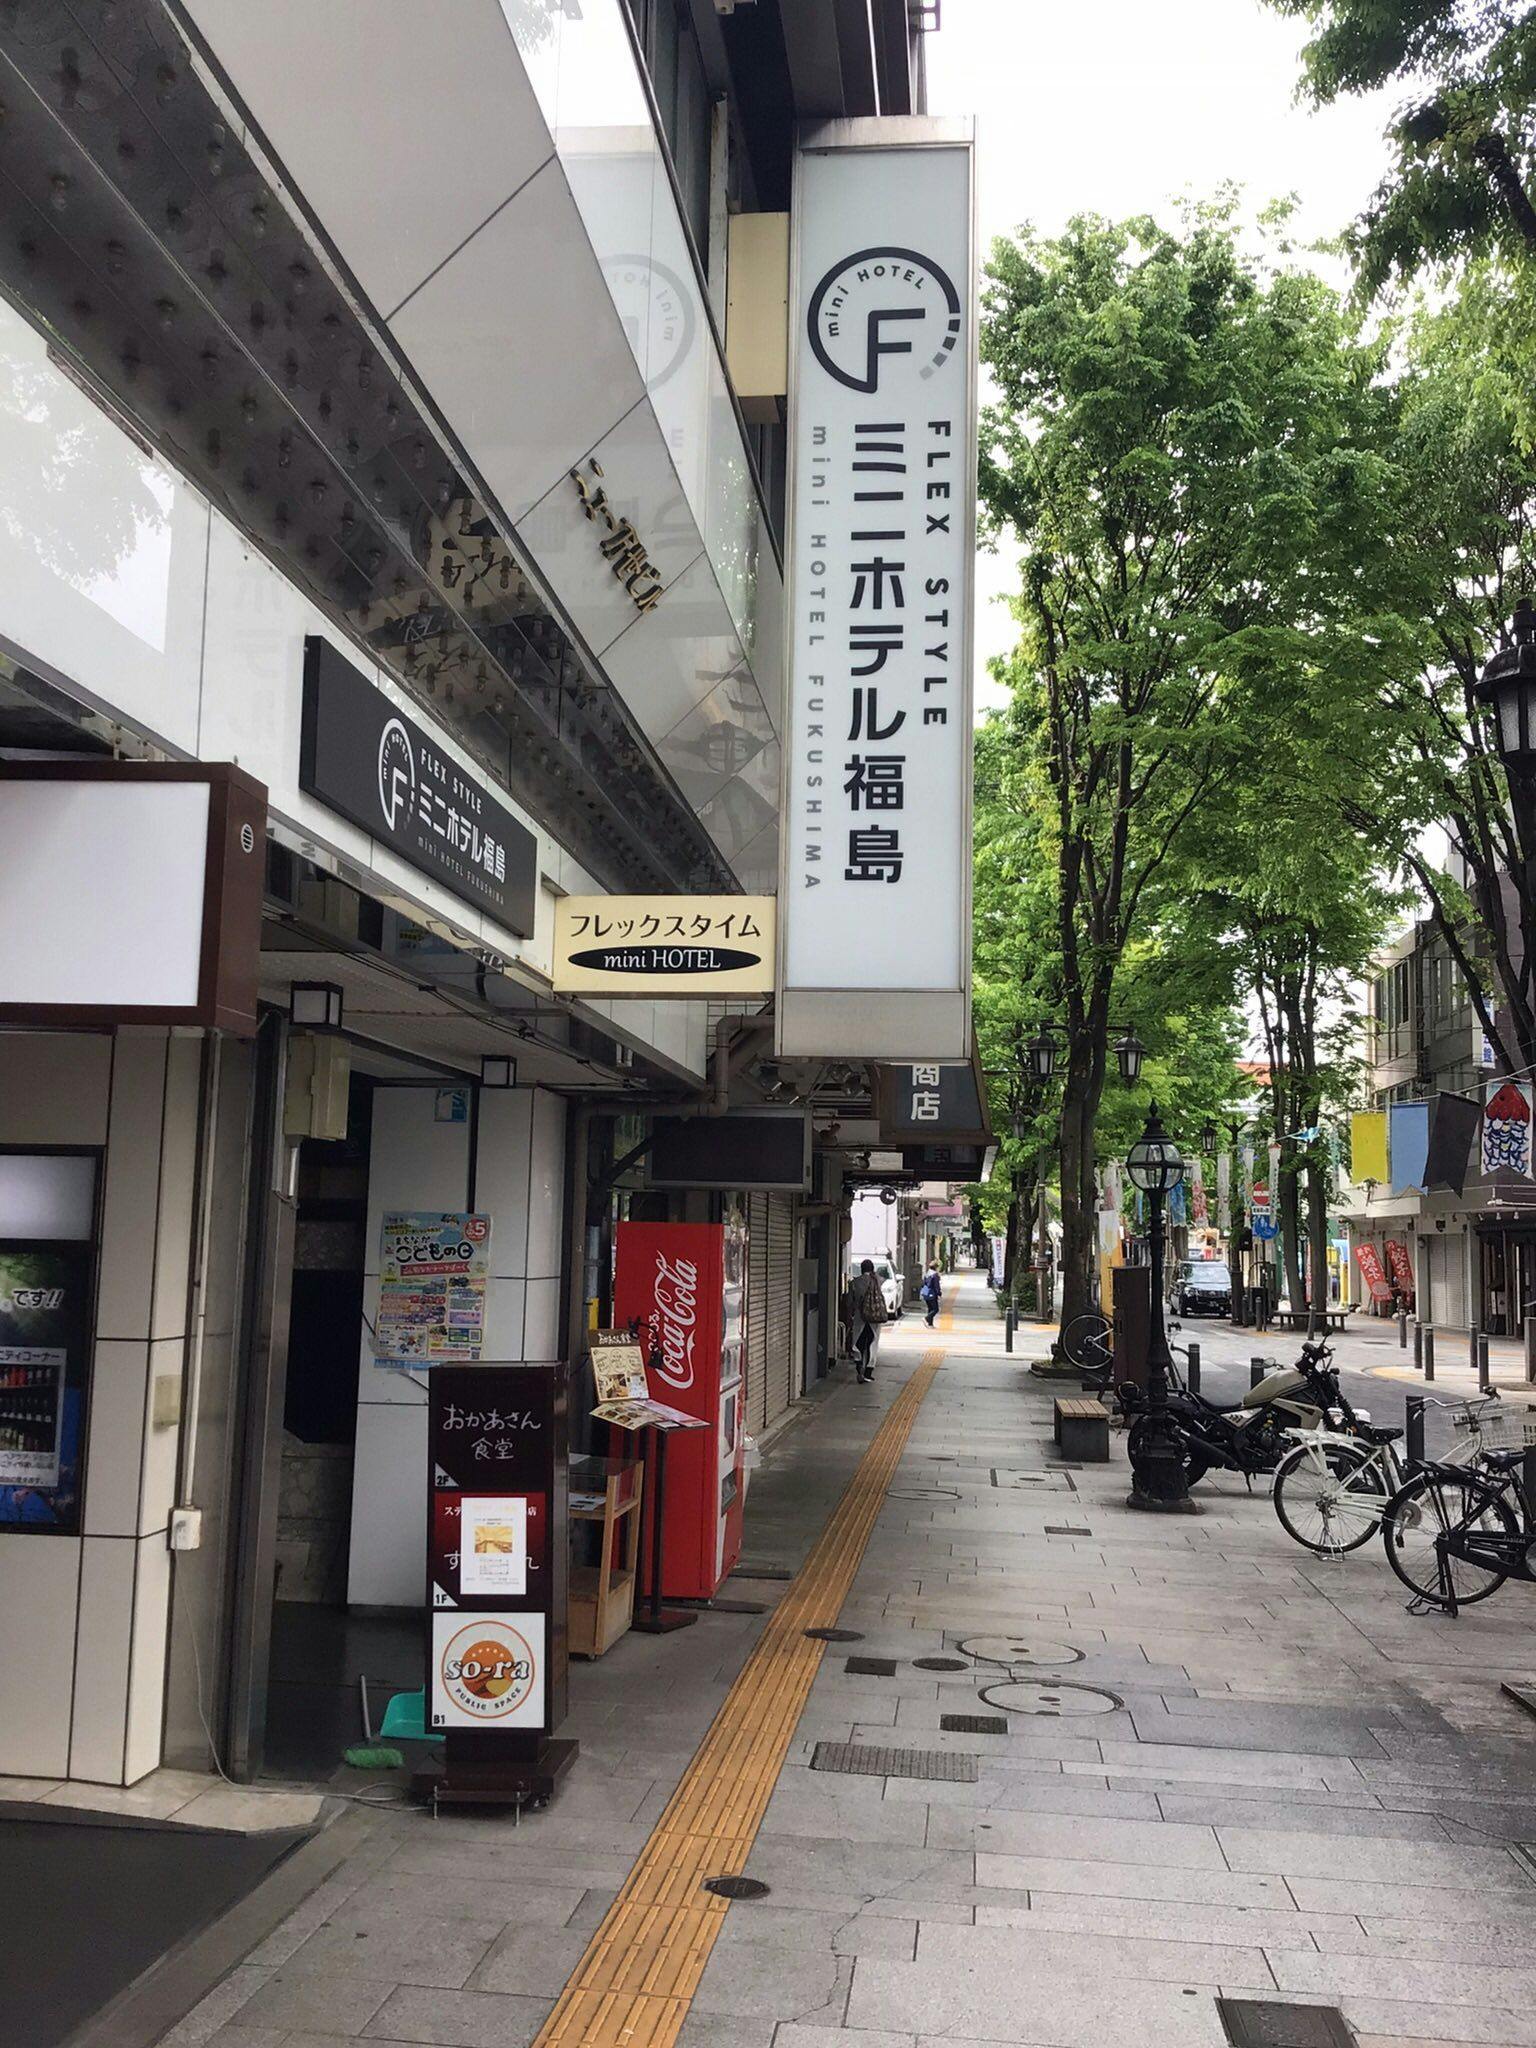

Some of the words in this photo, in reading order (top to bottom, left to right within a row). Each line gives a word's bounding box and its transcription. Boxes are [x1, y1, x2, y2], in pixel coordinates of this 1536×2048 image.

[825, 285, 850, 338] mini
[857, 265, 925, 290] HOTEL
[811, 425, 831, 507] mini
[925, 420, 951, 535] FLEX
[808, 534, 827, 647] HOTEL
[843, 422, 907, 884] ミニホテル福島
[922, 577, 950, 726] STYLE
[420, 748, 446, 784] FLEX
[452, 777, 482, 815] STYLE
[804, 675, 825, 889] FUKUSHIMA
[418, 782, 506, 884] ミニホテル福島
[418, 836, 437, 857] mini
[440, 851, 463, 877] HOTEL
[467, 870, 505, 905] FUKUSHIMA
[570, 914, 762, 939] フレックスタイム
[604, 950, 647, 969] mini
[651, 949, 722, 969] HOTEL
[655, 1250, 698, 1389] Coca-Cola
[443, 1403, 542, 1431] おかあさん
[471, 1437, 515, 1460] 食堂
[437, 1475, 450, 1486] 2F
[435, 1594, 448, 1605] 1F
[444, 1660, 530, 1681] so-ra
[455, 1687, 487, 1711] PUBLIC
[494, 1686, 522, 1710] SPACE
[433, 1714, 446, 1725] B1
